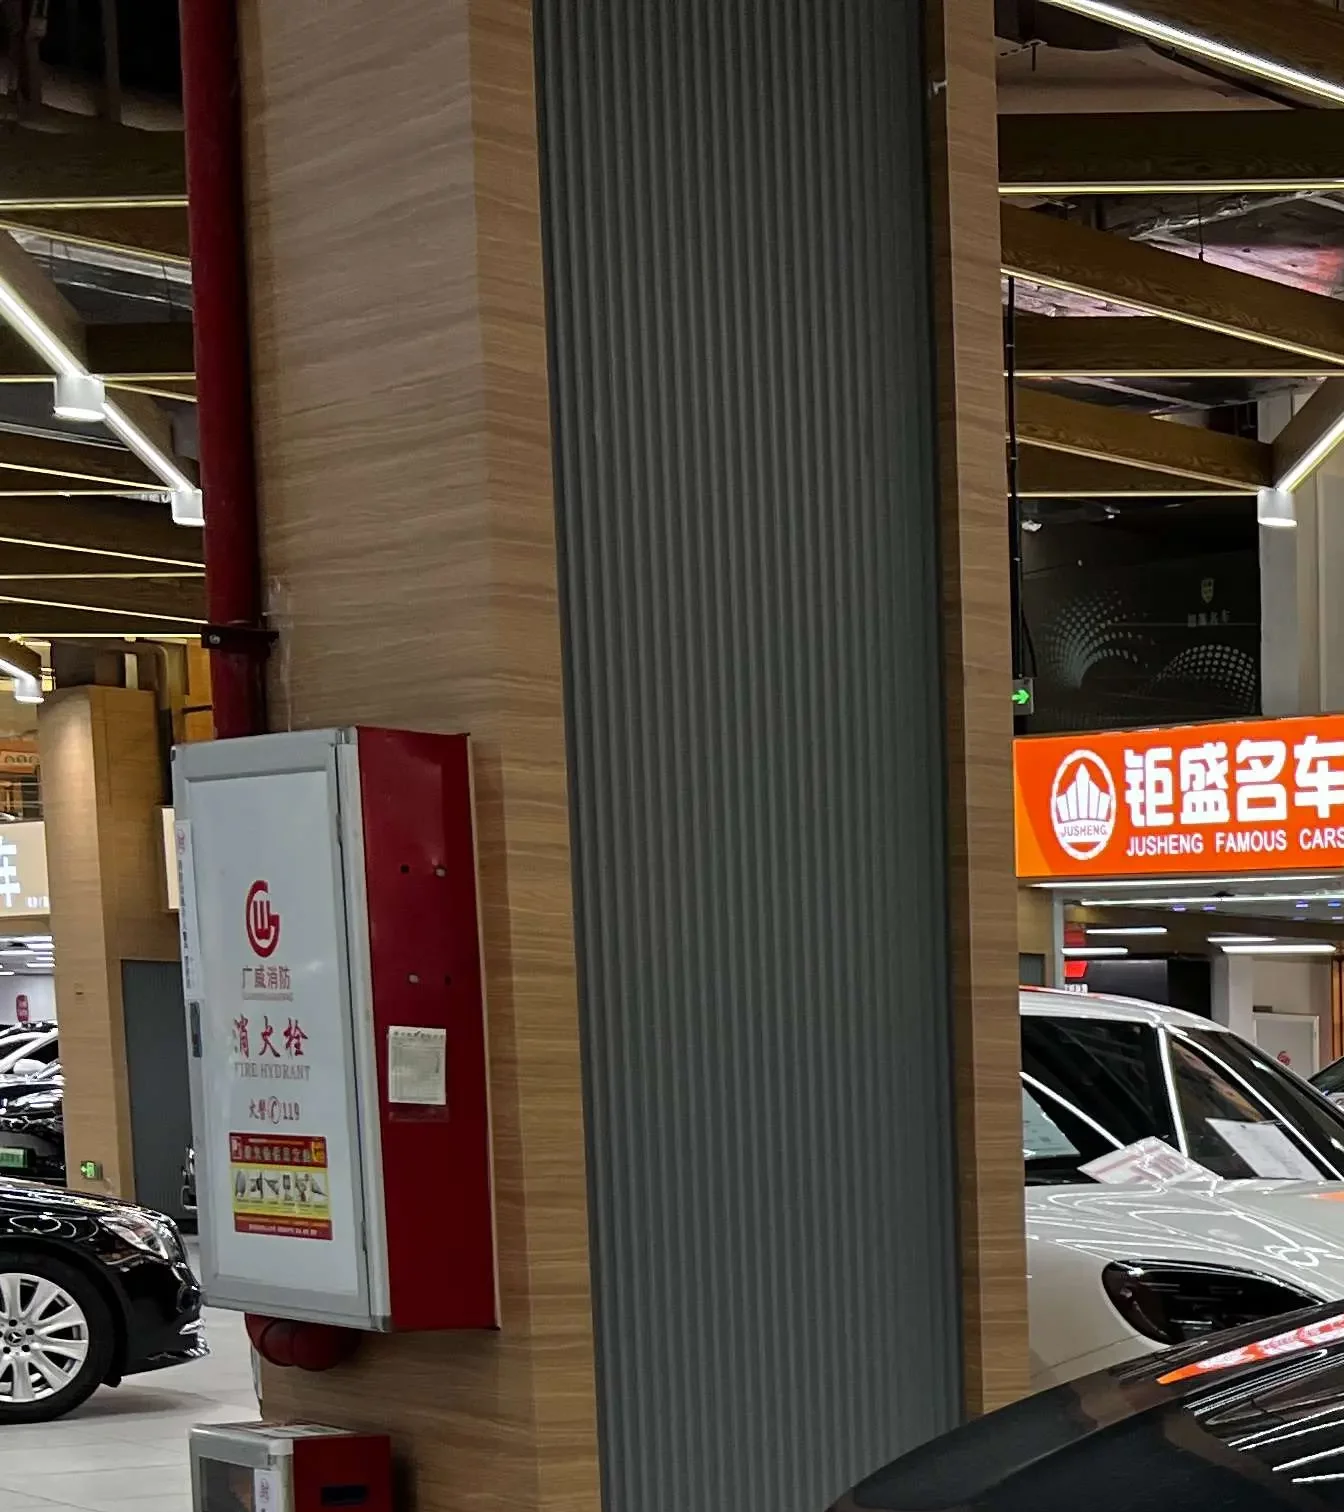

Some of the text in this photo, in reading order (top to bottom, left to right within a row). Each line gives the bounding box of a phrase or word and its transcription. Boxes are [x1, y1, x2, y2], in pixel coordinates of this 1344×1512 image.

[1061, 823, 1109, 838] JUSHENG
[1126, 832, 1204, 857] JUSHENG
[1215, 829, 1287, 854] FAMOUS
[232, 1014, 308, 1060] 消火栓
[234, 1062, 311, 1081] FIRE HYDRANT
[283, 1101, 300, 1121] 119
